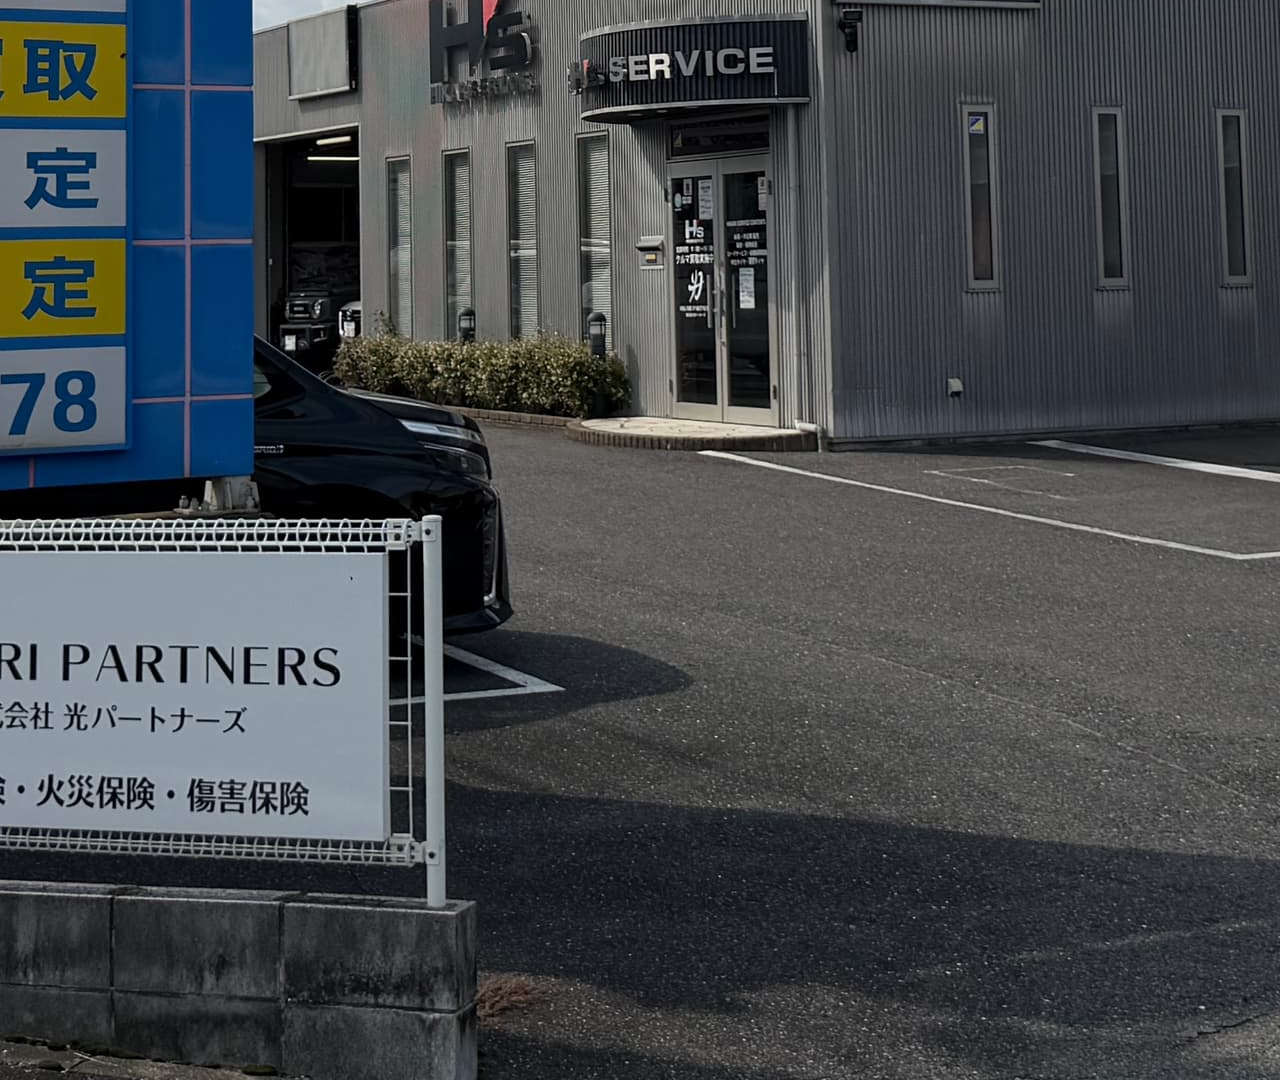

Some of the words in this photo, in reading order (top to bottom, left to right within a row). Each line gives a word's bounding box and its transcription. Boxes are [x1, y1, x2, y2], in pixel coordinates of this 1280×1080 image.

[608, 46, 775, 83] SERVICE
[62, 643, 342, 687] PARTNERS
[63, 701, 249, 734] 光パートナーズ
